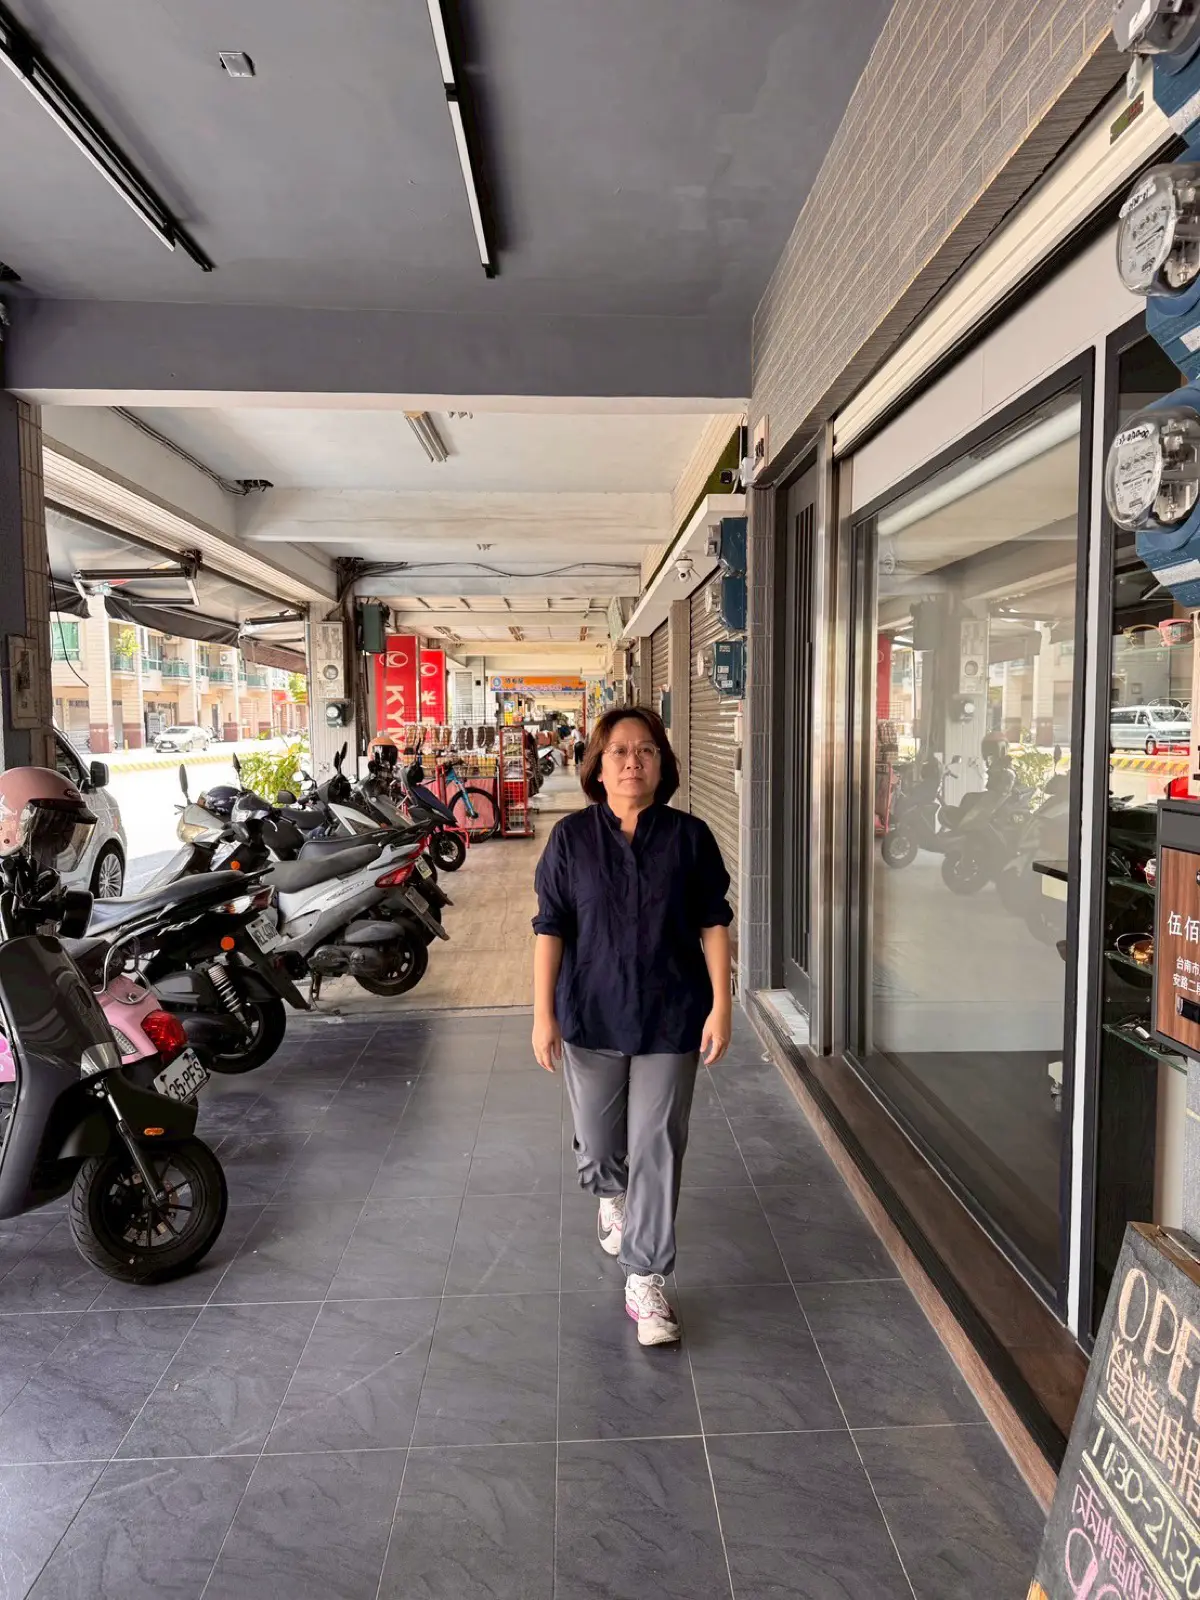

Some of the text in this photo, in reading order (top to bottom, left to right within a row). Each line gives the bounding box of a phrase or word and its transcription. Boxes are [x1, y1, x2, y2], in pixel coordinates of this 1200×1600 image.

[385, 685, 405, 756] KYM
[1167, 910, 1200, 945] 伍佰
[1176, 955, 1200, 977] 台南市
